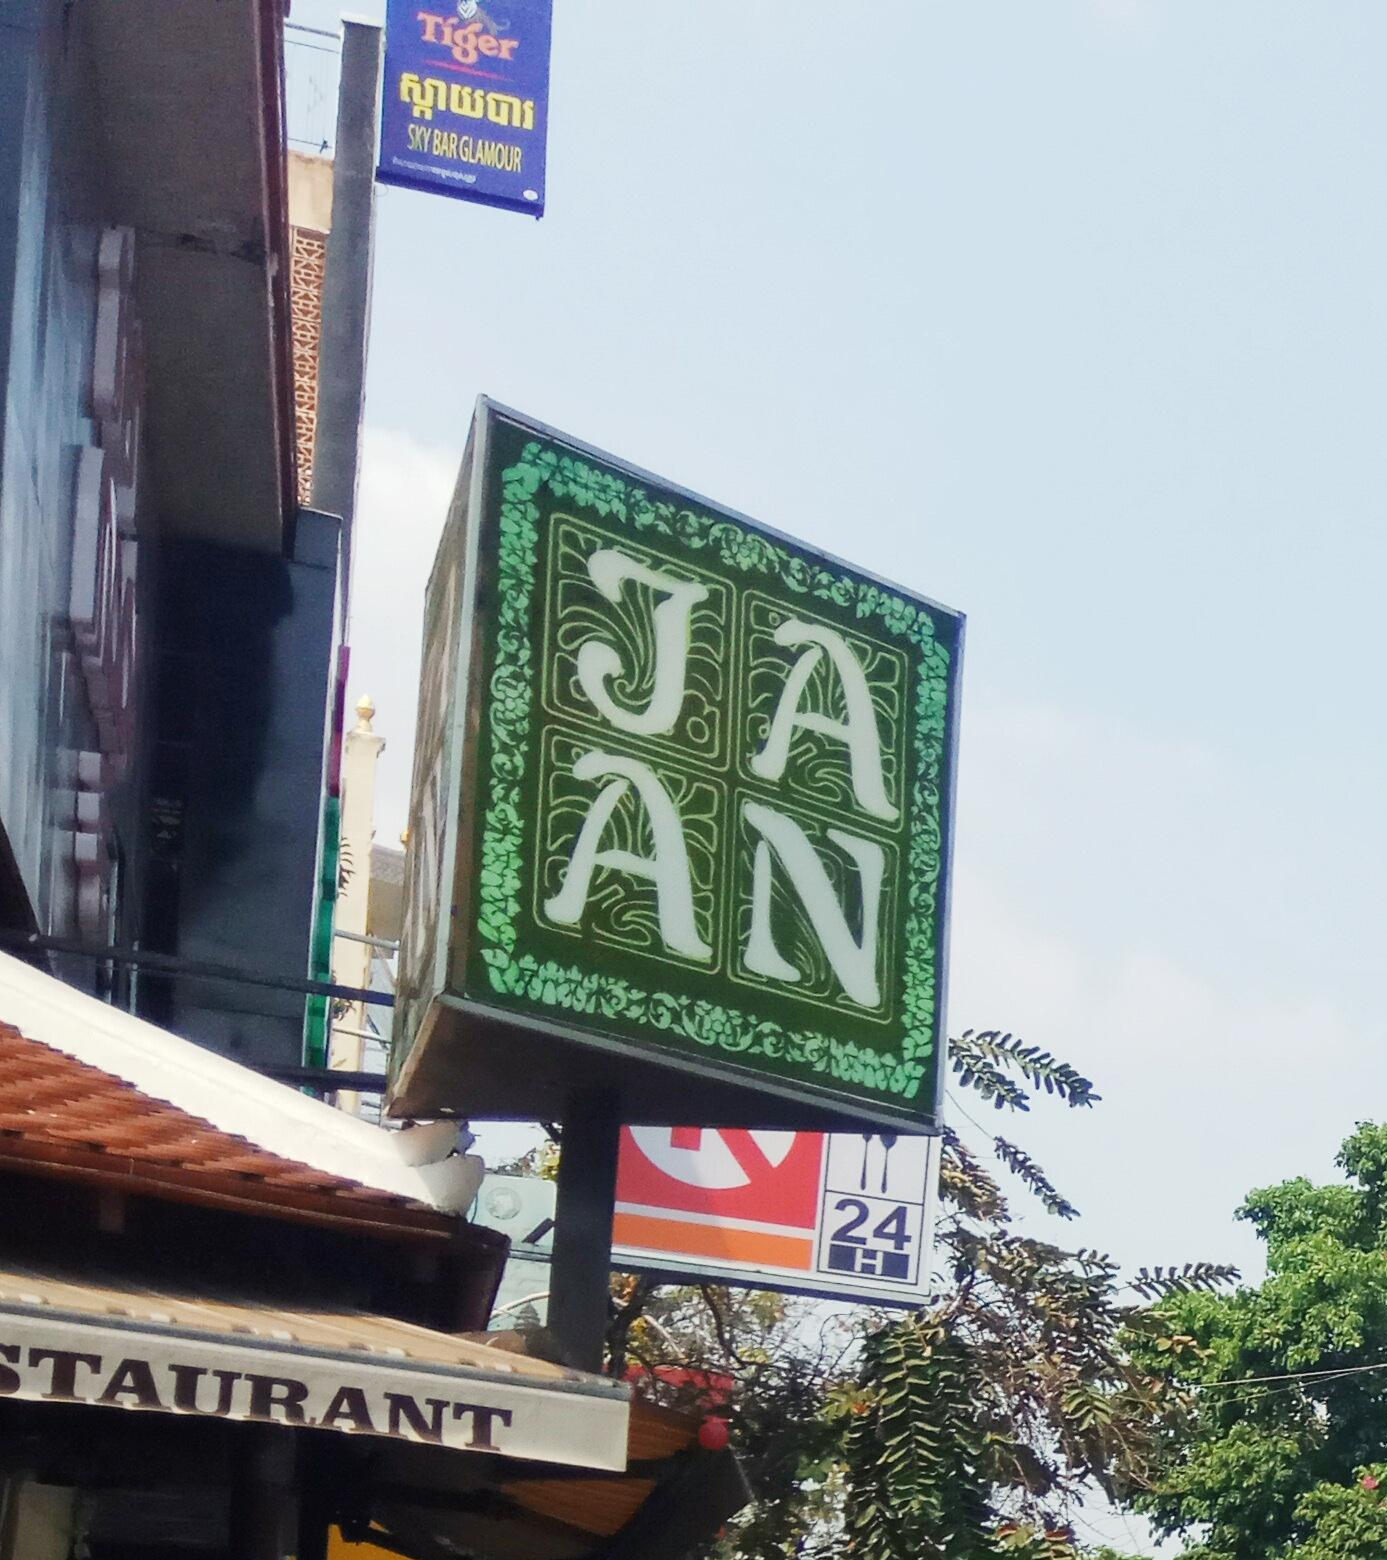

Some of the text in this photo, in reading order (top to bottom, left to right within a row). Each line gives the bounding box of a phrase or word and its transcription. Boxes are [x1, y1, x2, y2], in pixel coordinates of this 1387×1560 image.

[417, 11, 520, 64] Tiger
[407, 123, 432, 153] SKY
[433, 129, 458, 159] BAR
[459, 136, 522, 173] GLAMOUR
[829, 1198, 912, 1251] 24
[855, 1250, 885, 1275] H
